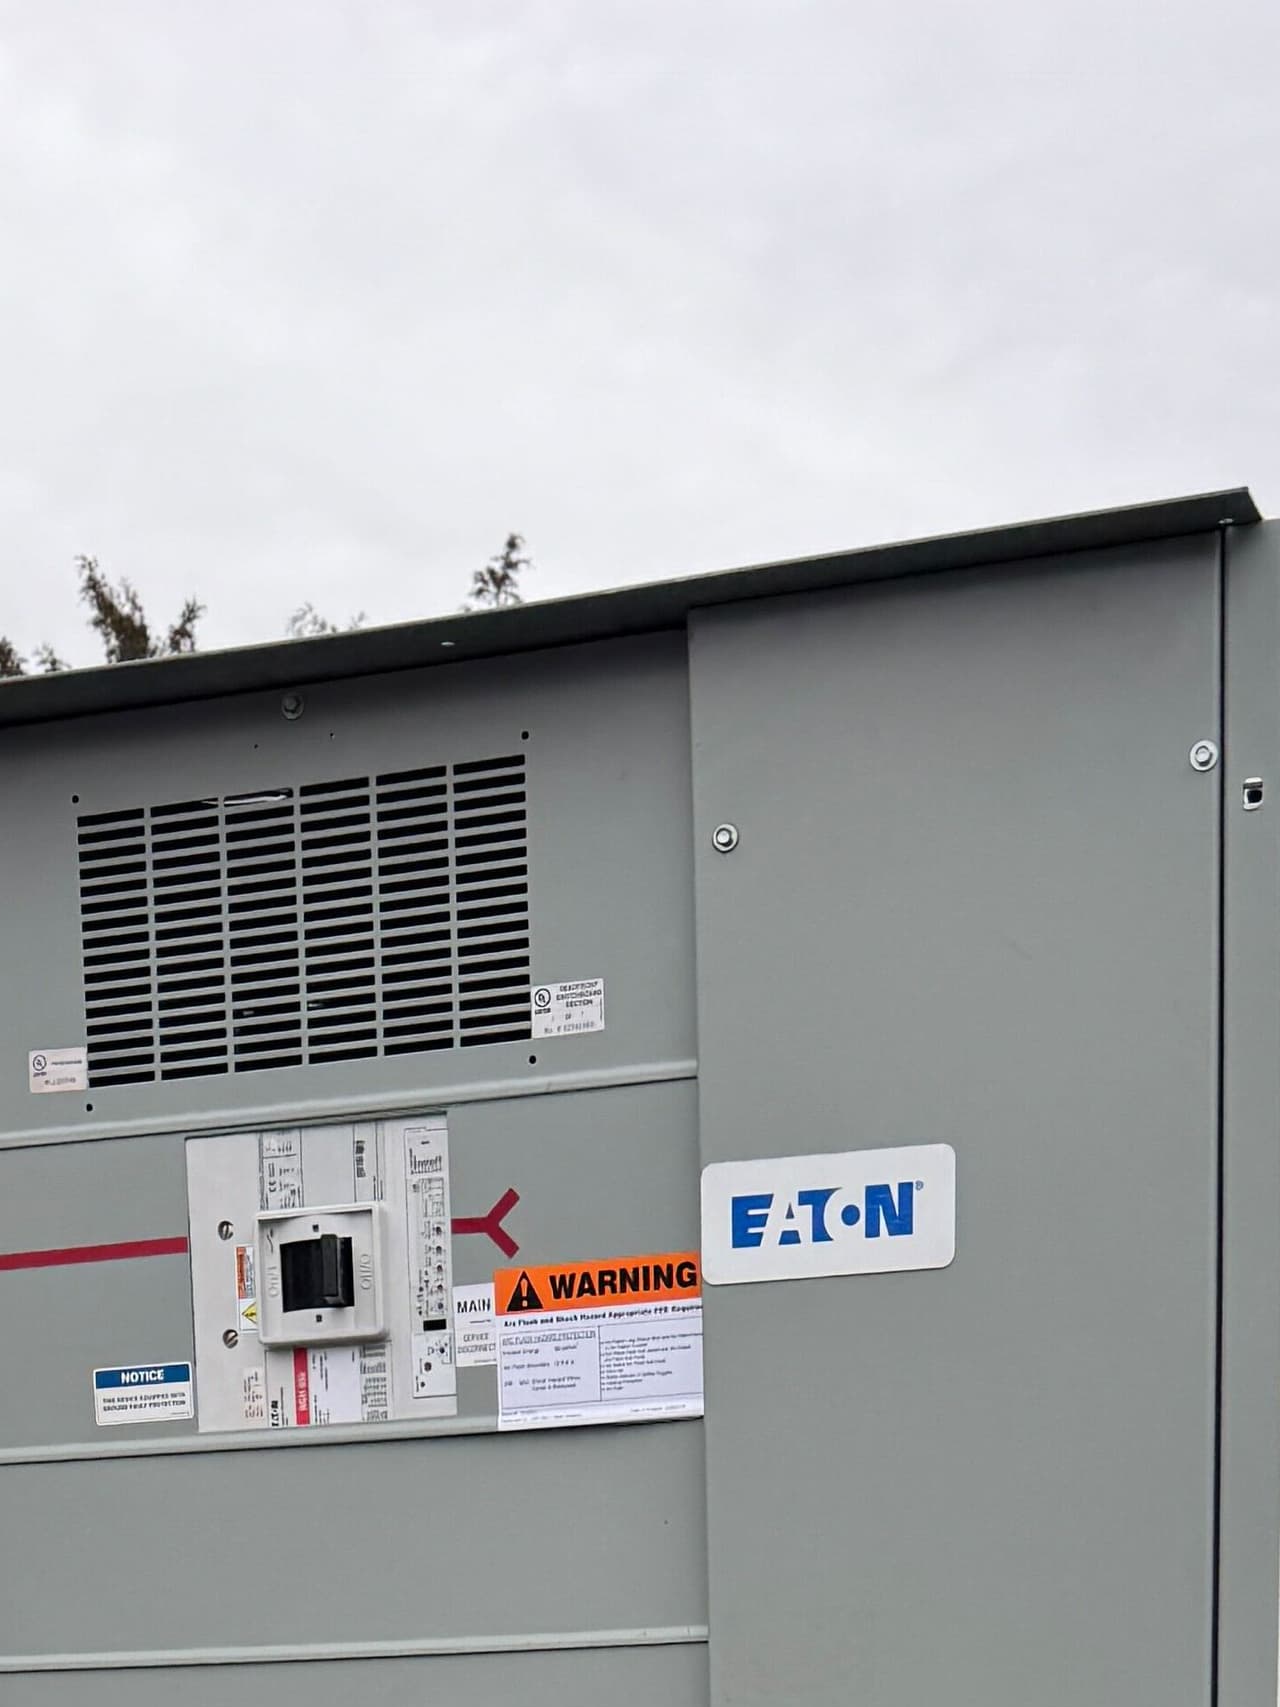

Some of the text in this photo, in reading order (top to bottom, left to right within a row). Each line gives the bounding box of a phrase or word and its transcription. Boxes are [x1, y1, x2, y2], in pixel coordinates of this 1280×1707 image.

[732, 1181, 914, 1248] EATON
[549, 1261, 697, 1300] WARNING
[457, 1298, 491, 1314] MAIN
[121, 1369, 165, 1384] NOTICE
